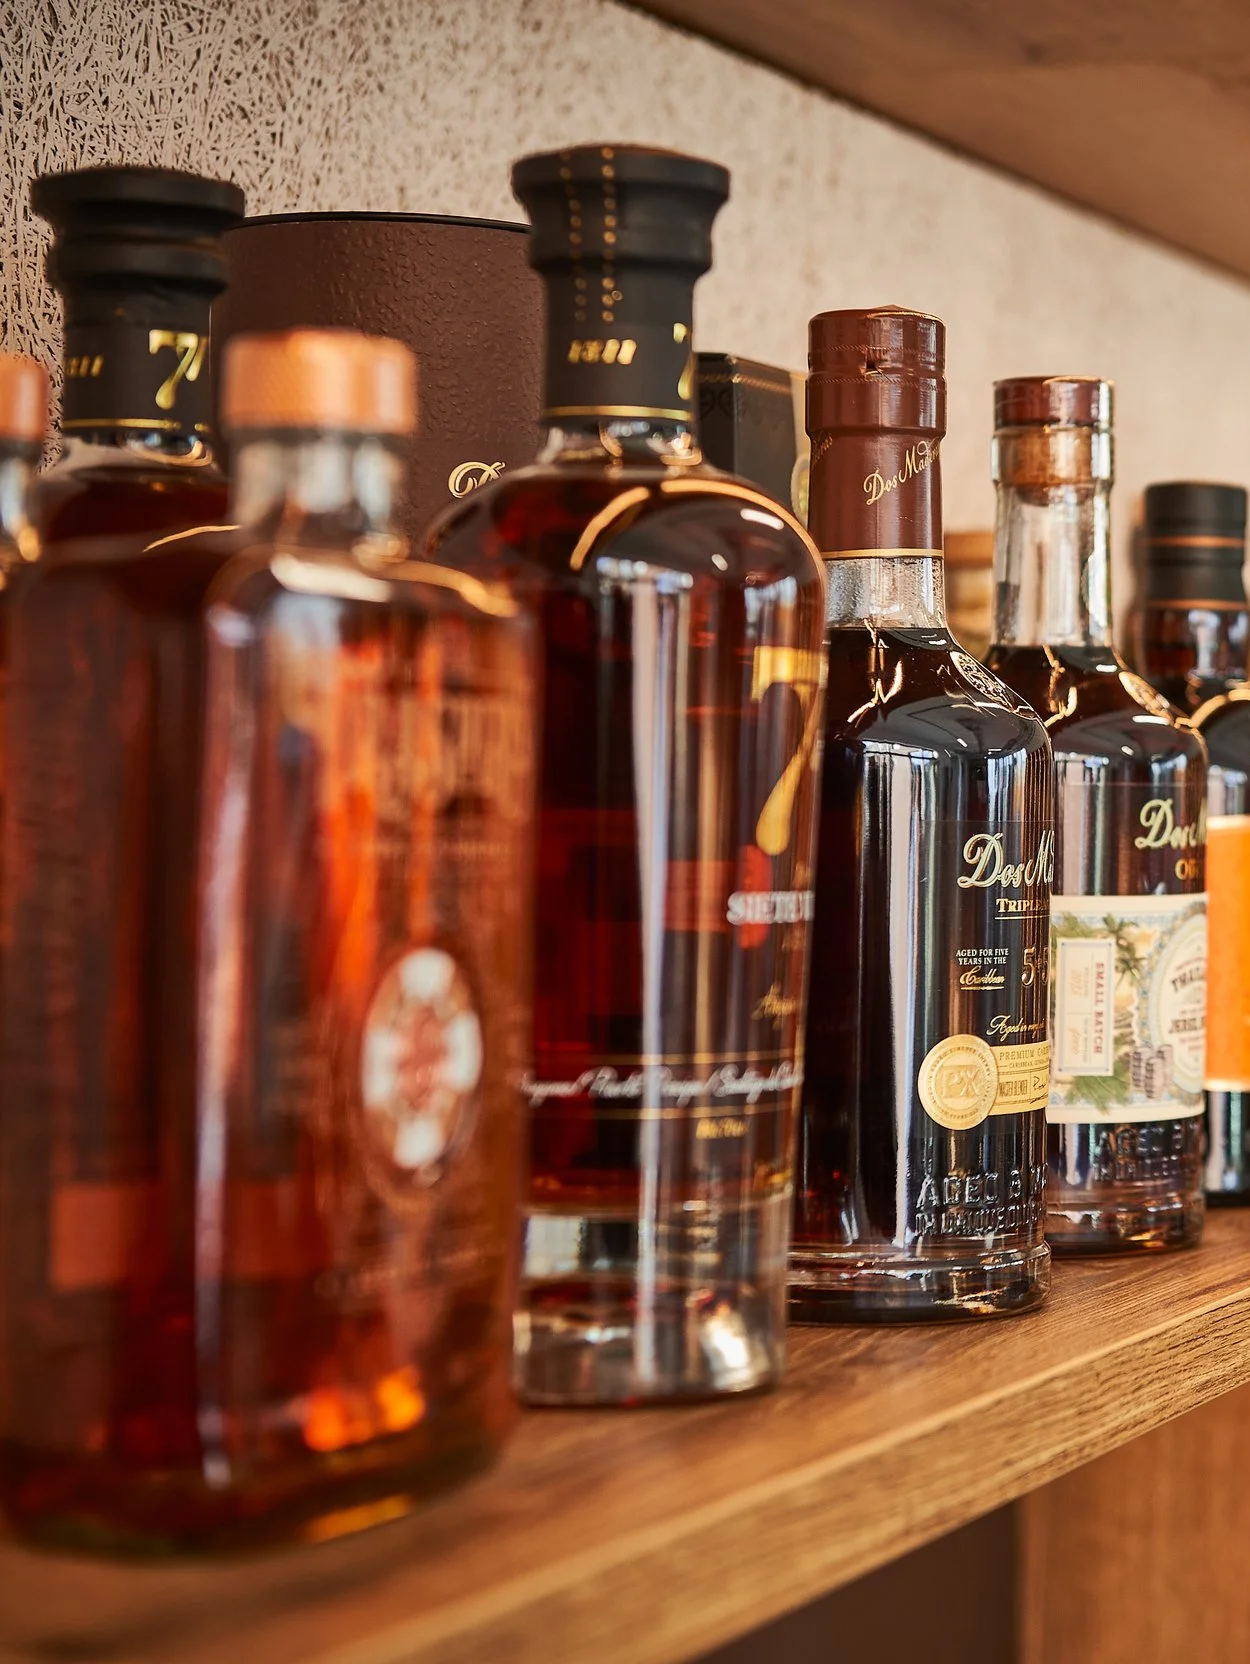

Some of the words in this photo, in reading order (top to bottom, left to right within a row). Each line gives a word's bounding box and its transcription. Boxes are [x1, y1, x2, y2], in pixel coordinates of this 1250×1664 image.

[863, 467, 898, 506] Dos
[957, 832, 1025, 889] Dos
[956, 949, 977, 957] AGED
[979, 949, 993, 957] FOR
[994, 948, 1009, 956] FIVE
[958, 958, 982, 966] YEARS
[983, 957, 992, 965] IN
[960, 966, 1006, 985] Caribbean
[1095, 962, 1105, 1006] SMALL
[986, 1015, 1023, 1042] Aged
[1093, 1011, 1104, 1054] BATCH
[1000, 1050, 1035, 1060] PREMIUM
[942, 1067, 981, 1099] PX
